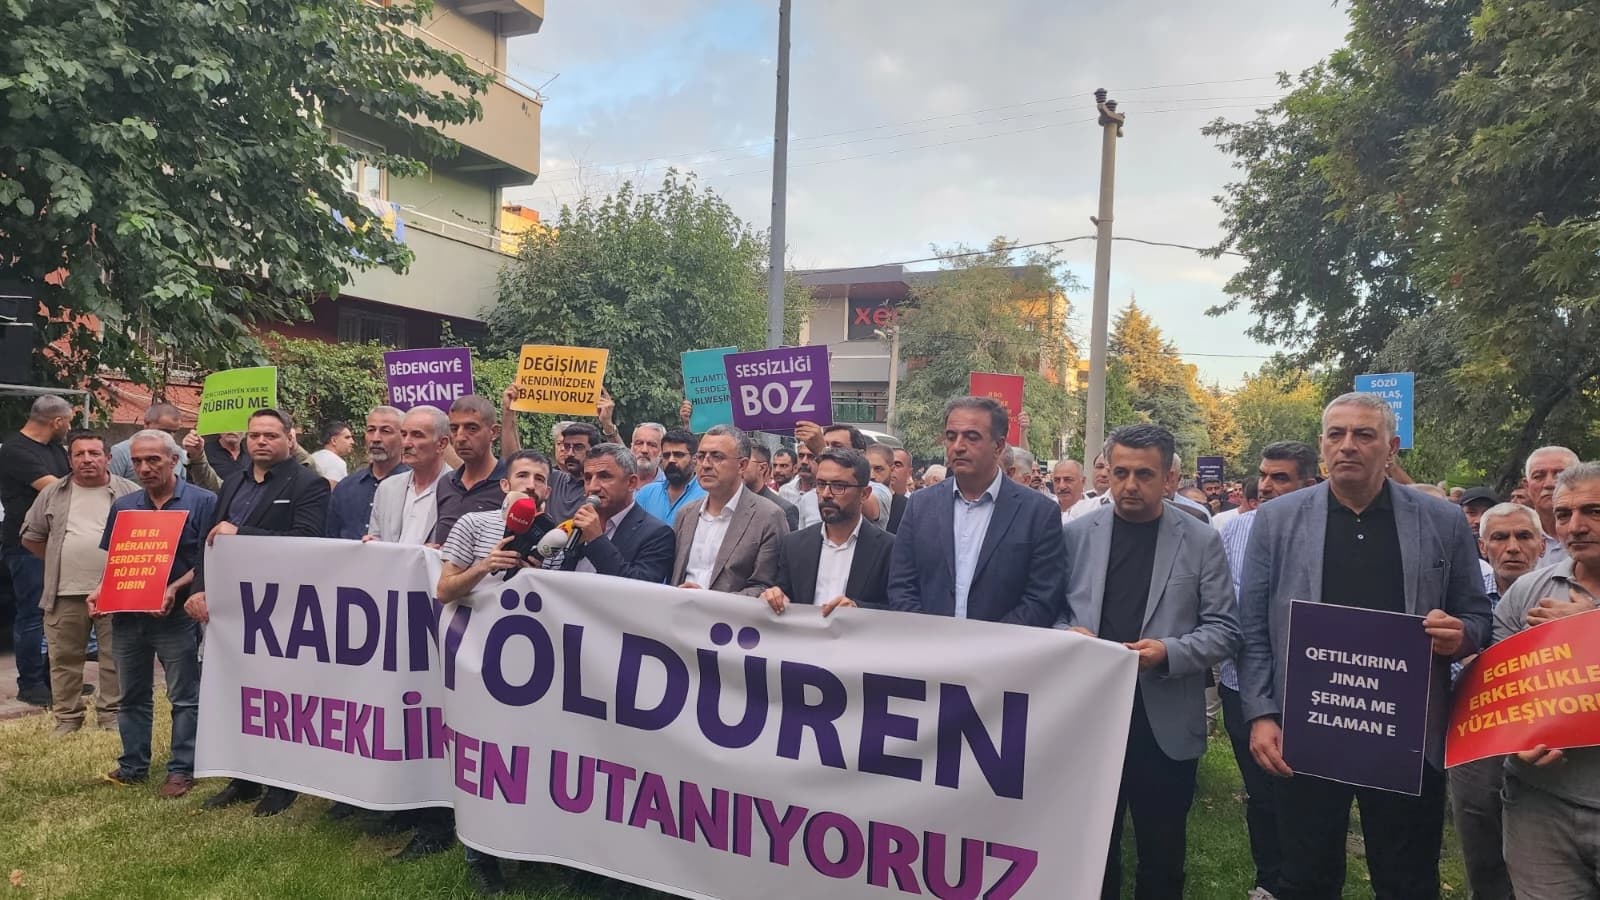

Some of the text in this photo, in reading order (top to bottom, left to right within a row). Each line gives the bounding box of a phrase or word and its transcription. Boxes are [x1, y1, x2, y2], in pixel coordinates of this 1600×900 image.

[389, 357, 463, 376] BÊDENGIYÊ
[523, 355, 599, 376] DEĞİŞİME
[735, 355, 812, 378] SESSİZLİĞİ
[520, 375, 595, 389] KENDİMİZDEN
[695, 384, 729, 395] SERDES
[248, 396, 269, 408] ME
[392, 380, 464, 407] BIŞKÎNE
[519, 388, 595, 404] BAŞLIYORUZ
[740, 379, 816, 417] BOZ
[130, 528, 160, 538] EM BI
[115, 540, 169, 552] MÊRANIYA
[109, 553, 169, 565] SERDEST RE
[128, 567, 140, 577] BI
[116, 580, 146, 591] DIBIN
[1305, 647, 1408, 673] QETILKIRINA
[1483, 643, 1573, 684] EGEMEN
[1329, 672, 1379, 690] JINAN
[481, 588, 1030, 800] ÖLDÜREN
[1311, 690, 1396, 715] ŞERMA ME
[1307, 711, 1397, 737] ZILAMAN E
[240, 686, 1039, 900] ERKEKLİKEN UTANIYORUZ
